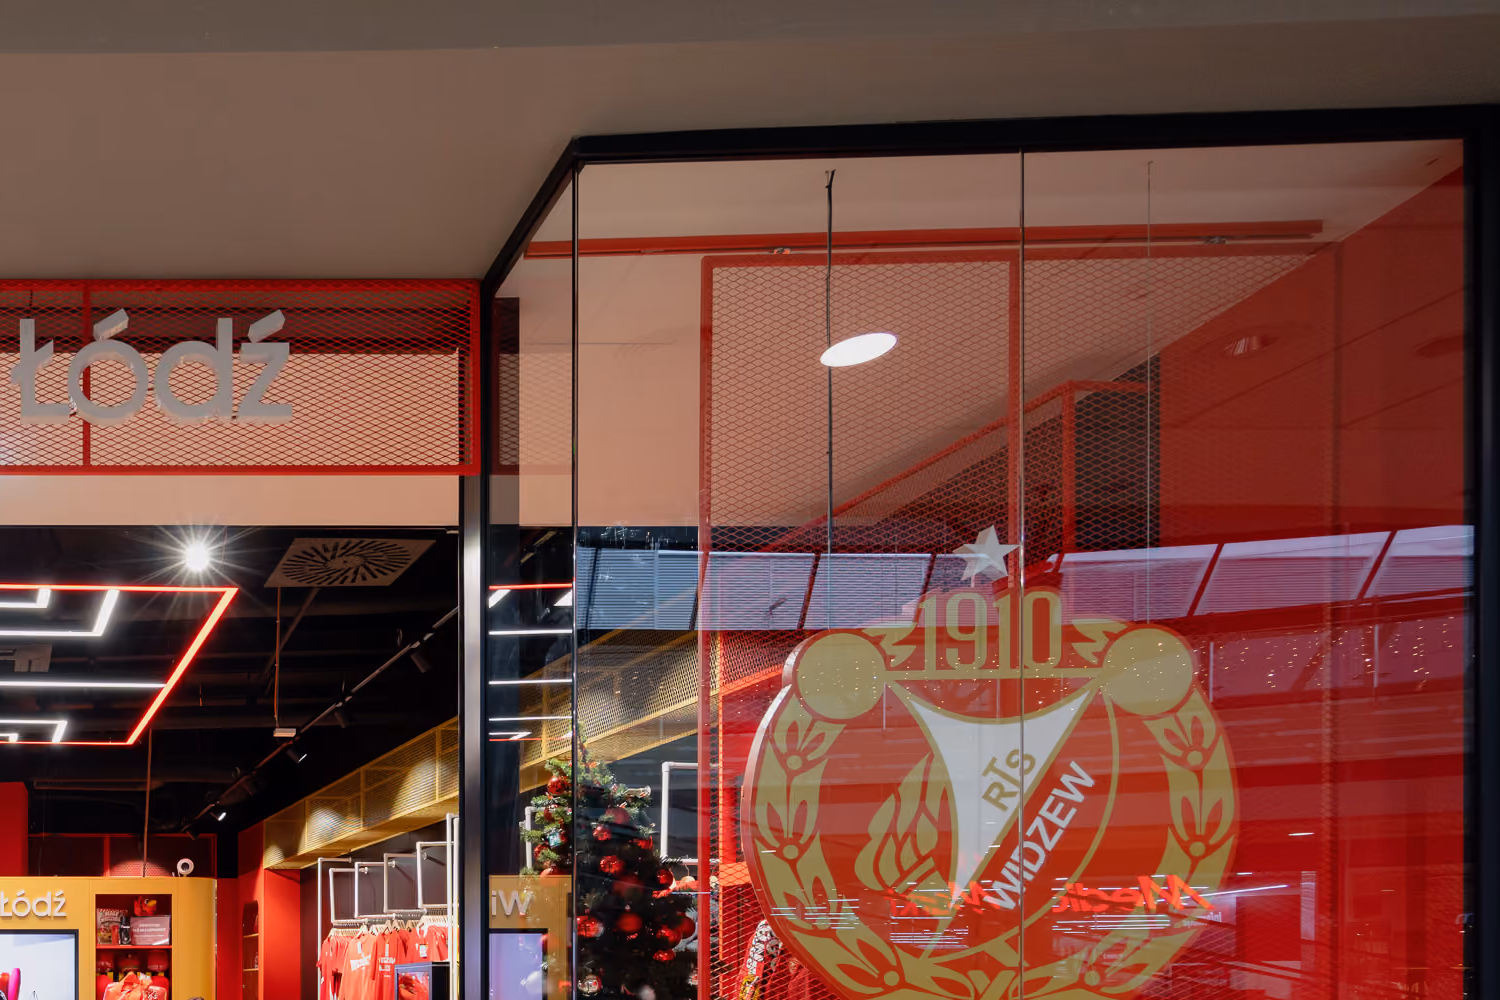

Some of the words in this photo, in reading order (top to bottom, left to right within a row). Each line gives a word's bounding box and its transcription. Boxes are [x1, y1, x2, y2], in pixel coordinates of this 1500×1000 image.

[10, 308, 293, 426] Łódź
[918, 592, 1063, 670] 1910
[982, 749, 1036, 812] RTS
[983, 761, 1095, 910] WIDZEW
